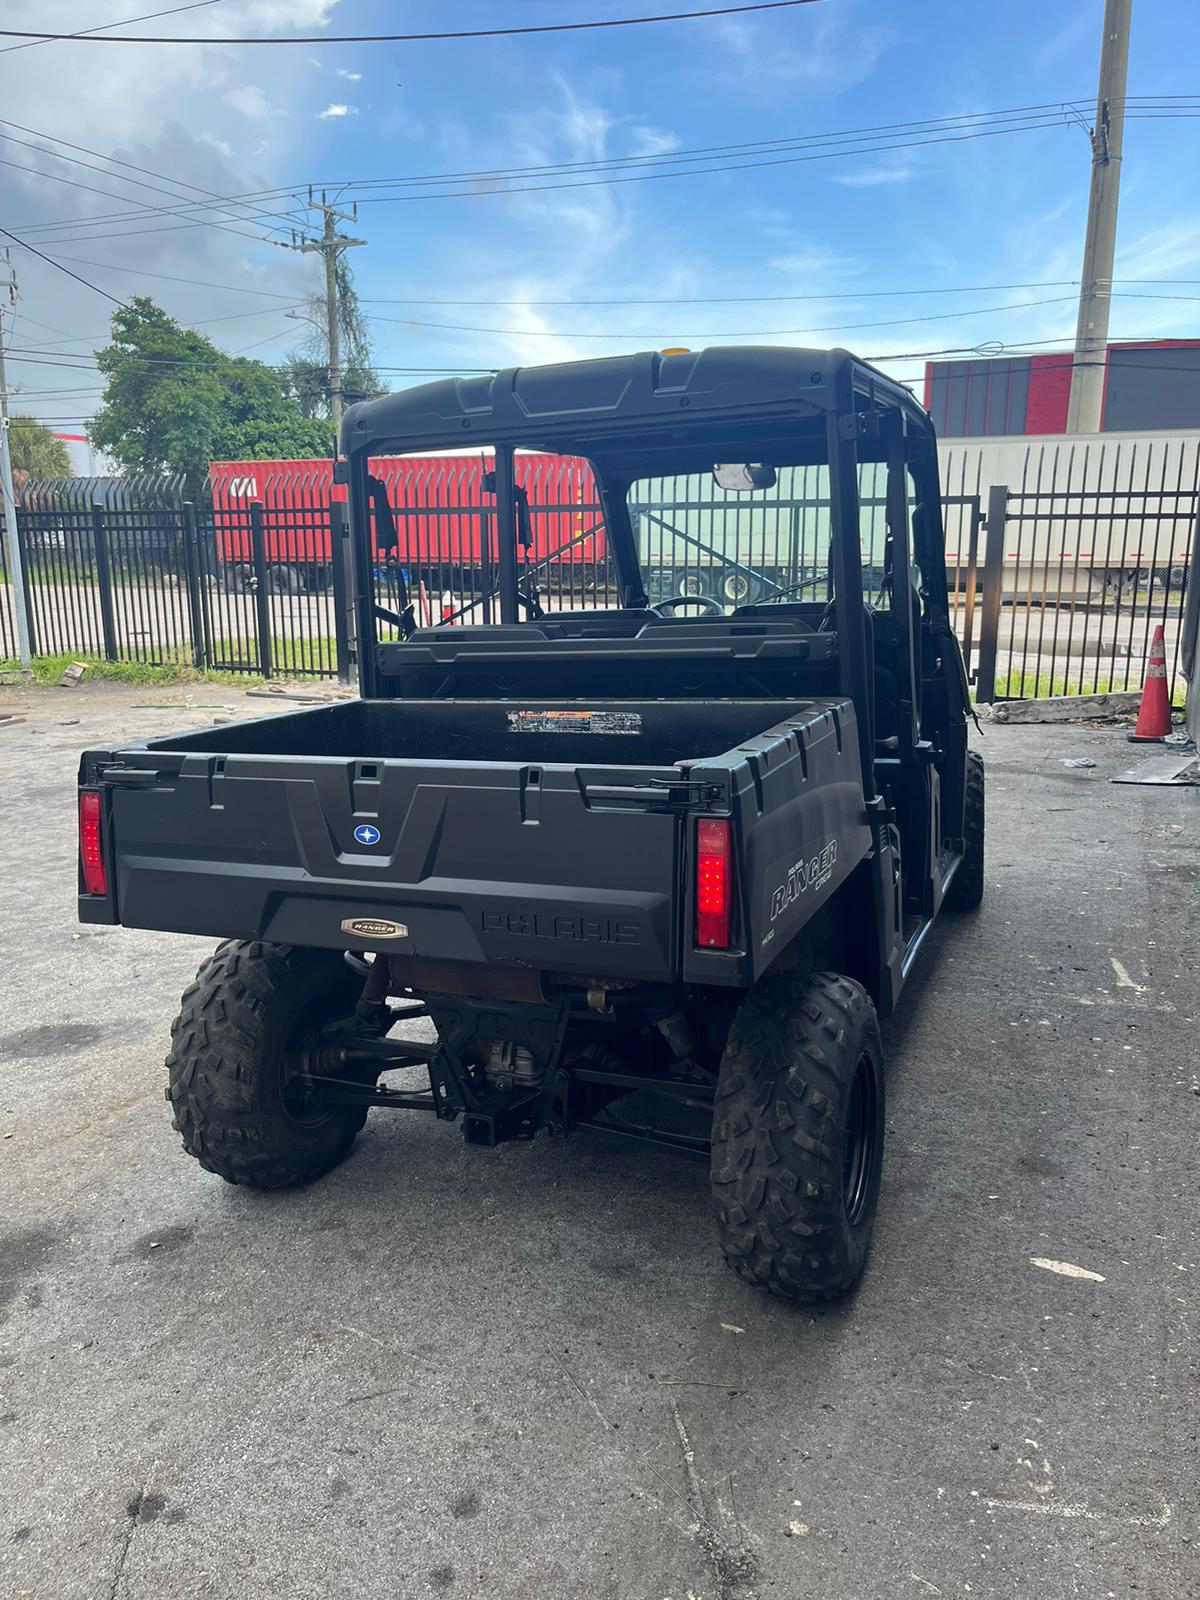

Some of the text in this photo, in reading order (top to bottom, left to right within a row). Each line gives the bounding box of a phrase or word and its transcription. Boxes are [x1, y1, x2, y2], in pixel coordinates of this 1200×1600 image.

[770, 839, 837, 921] RANGER
[354, 924, 395, 932] RANGER
[481, 909, 641, 946] POLARIS
